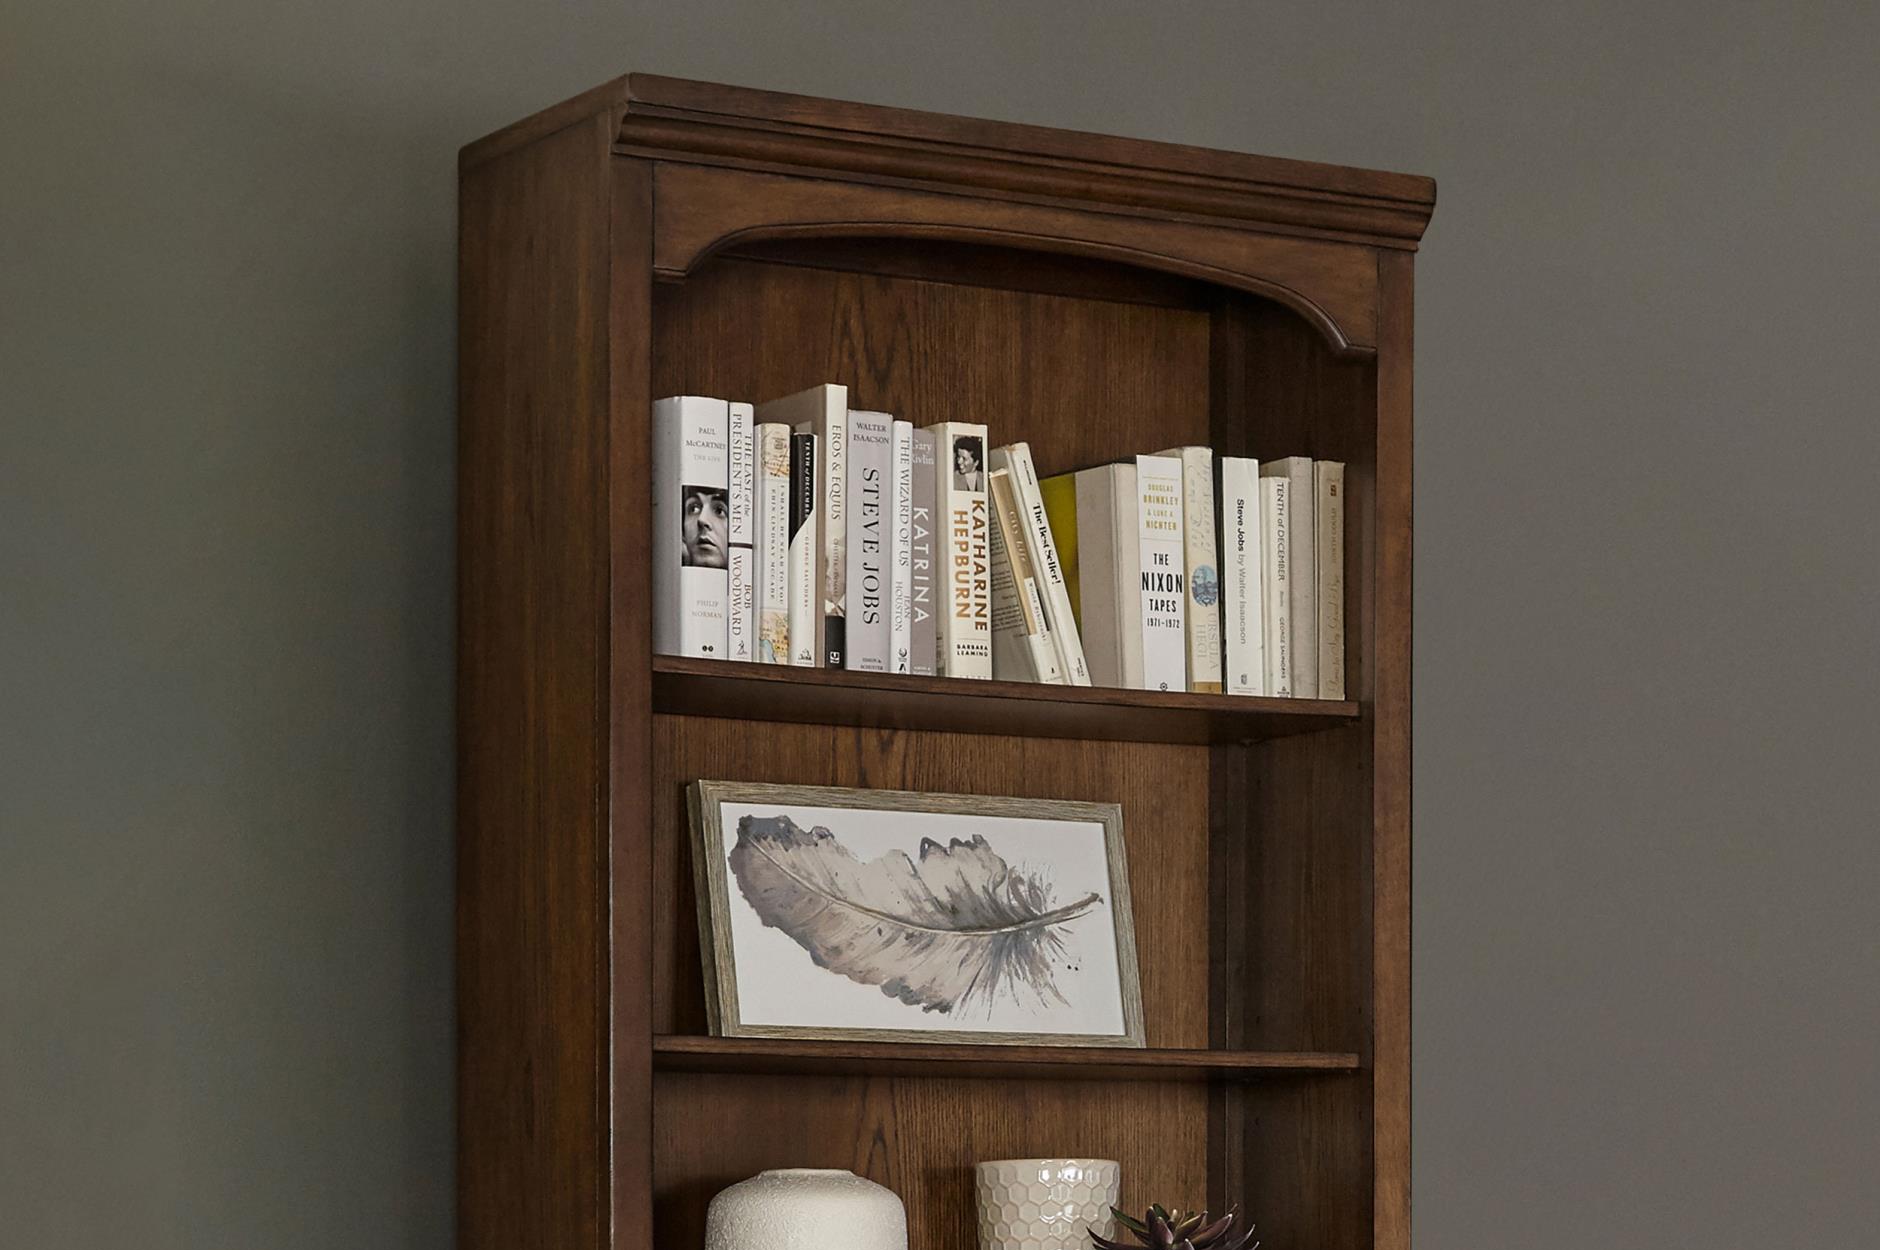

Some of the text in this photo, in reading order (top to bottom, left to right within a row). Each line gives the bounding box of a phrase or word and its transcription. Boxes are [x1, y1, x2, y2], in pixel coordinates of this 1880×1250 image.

[698, 426, 716, 436] PAUL
[744, 434, 752, 460] THE
[853, 434, 889, 445] ISAACSON
[856, 422, 887, 433] WALTER
[732, 413, 742, 535] PRESIDENT'S MEN
[744, 463, 752, 494] LAST
[831, 424, 842, 521] EROS & EQUUS
[1143, 494, 1179, 505] BRINKLEY
[899, 437, 910, 567] THE WIZARD OF US
[1145, 519, 1177, 531] NICHTER
[862, 468, 880, 624] STEVE JOBS
[1033, 502, 1062, 585] The Best Seller!
[1153, 553, 1169, 566] THE
[1276, 482, 1286, 582] TENTH of DECEMBER
[913, 506, 930, 623] KATRINA
[953, 510, 971, 618] HEPBURN
[972, 500, 988, 631] KATHARINE
[1142, 571, 1183, 593] NIXON
[1237, 498, 1248, 646] Steve Jobs by Walter Isaacson
[732, 555, 742, 636] WOODWARD
[744, 584, 752, 609] BOB
[895, 581, 903, 632] HOUSTON
[1149, 598, 1177, 612] TAPES
[1207, 612, 1219, 671] URSULA
